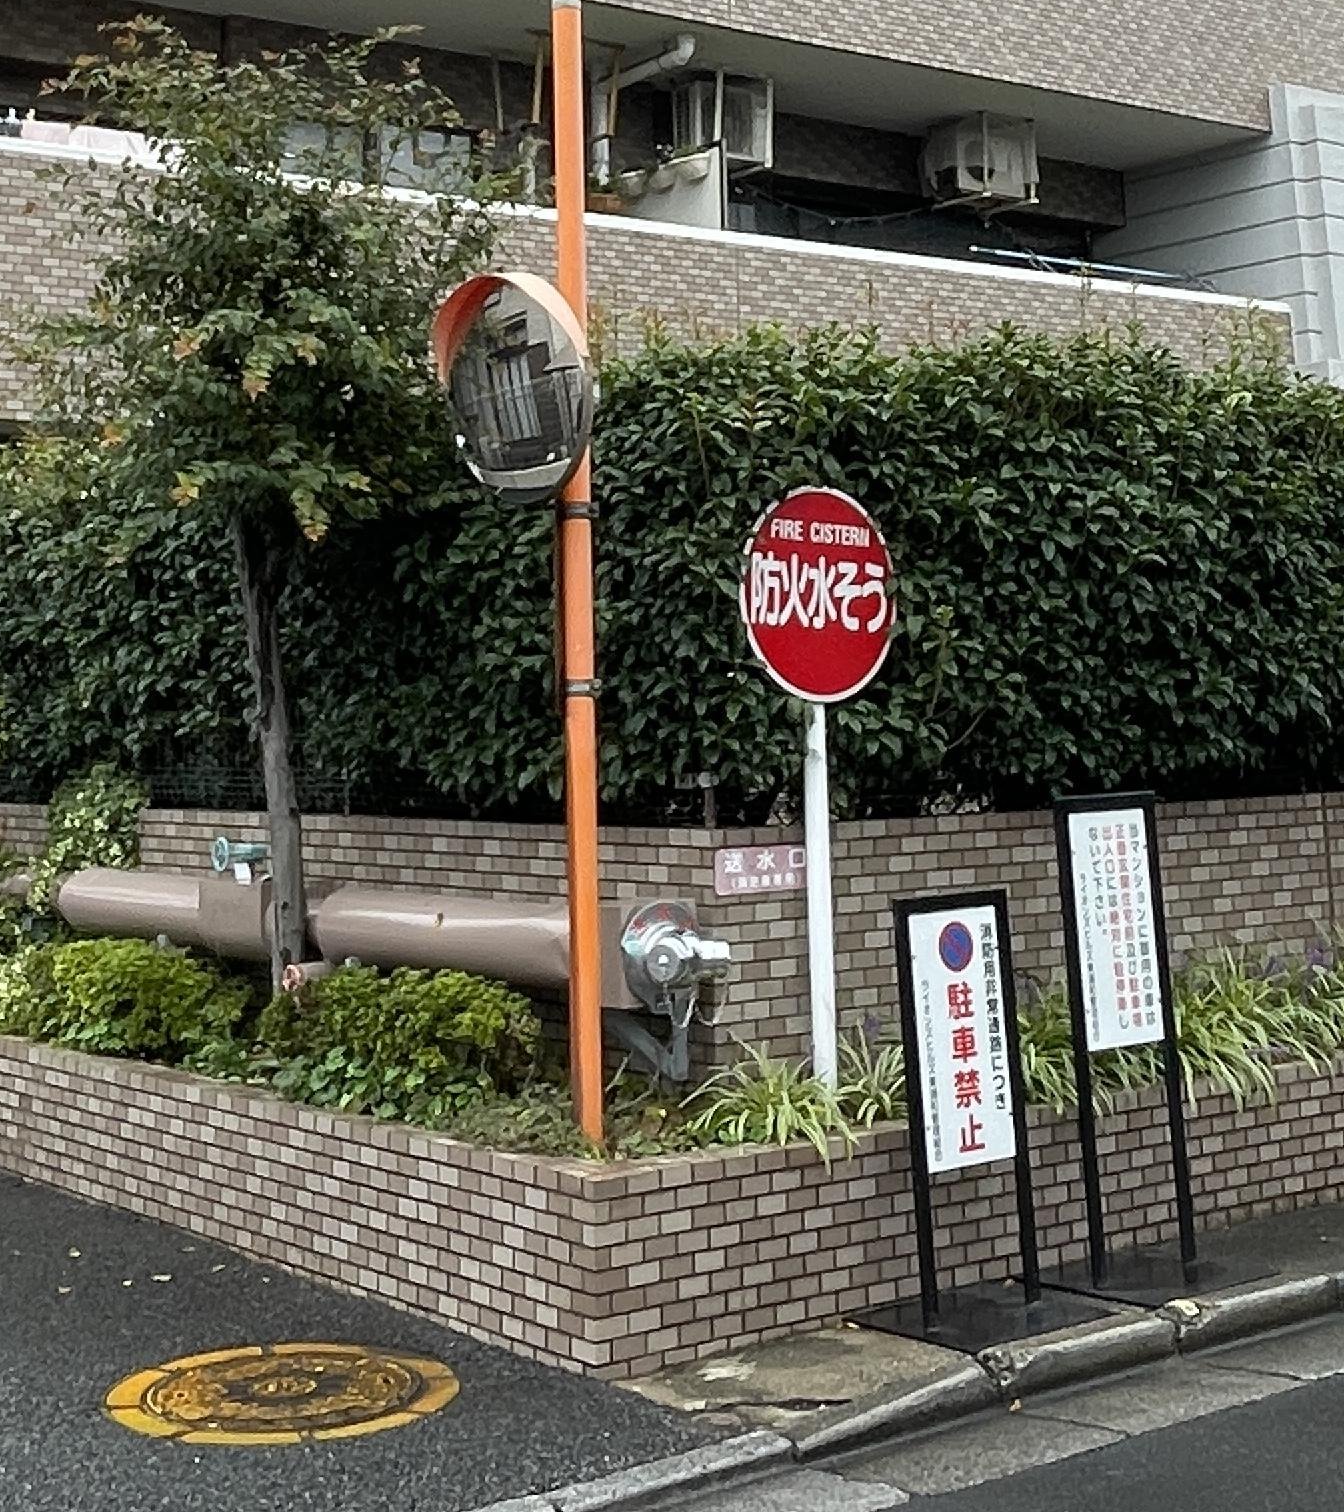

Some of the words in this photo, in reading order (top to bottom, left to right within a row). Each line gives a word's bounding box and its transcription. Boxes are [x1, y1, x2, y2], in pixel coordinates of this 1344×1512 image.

[770, 518, 804, 541] FIRE
[809, 522, 870, 547] CISTERN
[750, 550, 888, 633] 防火水そう
[946, 980, 986, 1154] 駐車禁止
